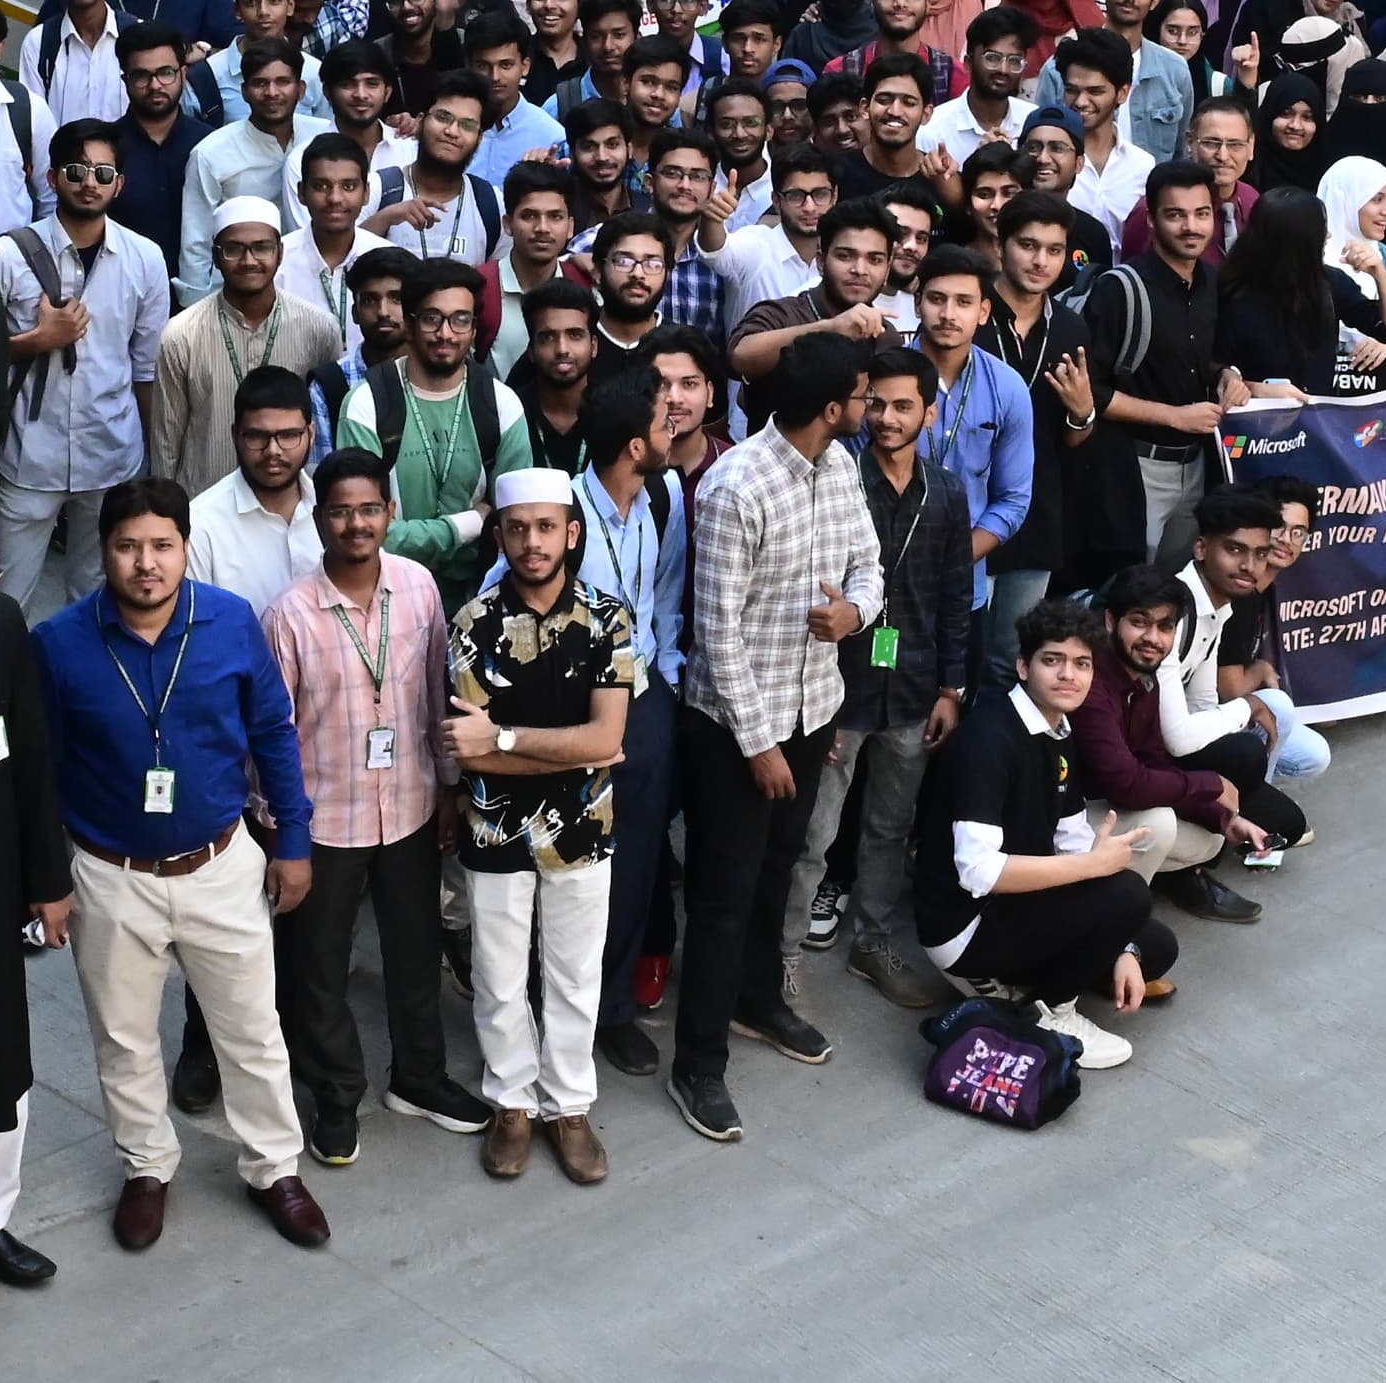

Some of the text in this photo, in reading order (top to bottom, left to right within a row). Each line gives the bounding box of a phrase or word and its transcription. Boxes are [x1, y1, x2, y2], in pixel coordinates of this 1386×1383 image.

[1247, 430, 1307, 456] Microsoft
[1328, 526, 1378, 546] YOUR
[1318, 619, 1368, 646] 27TH
